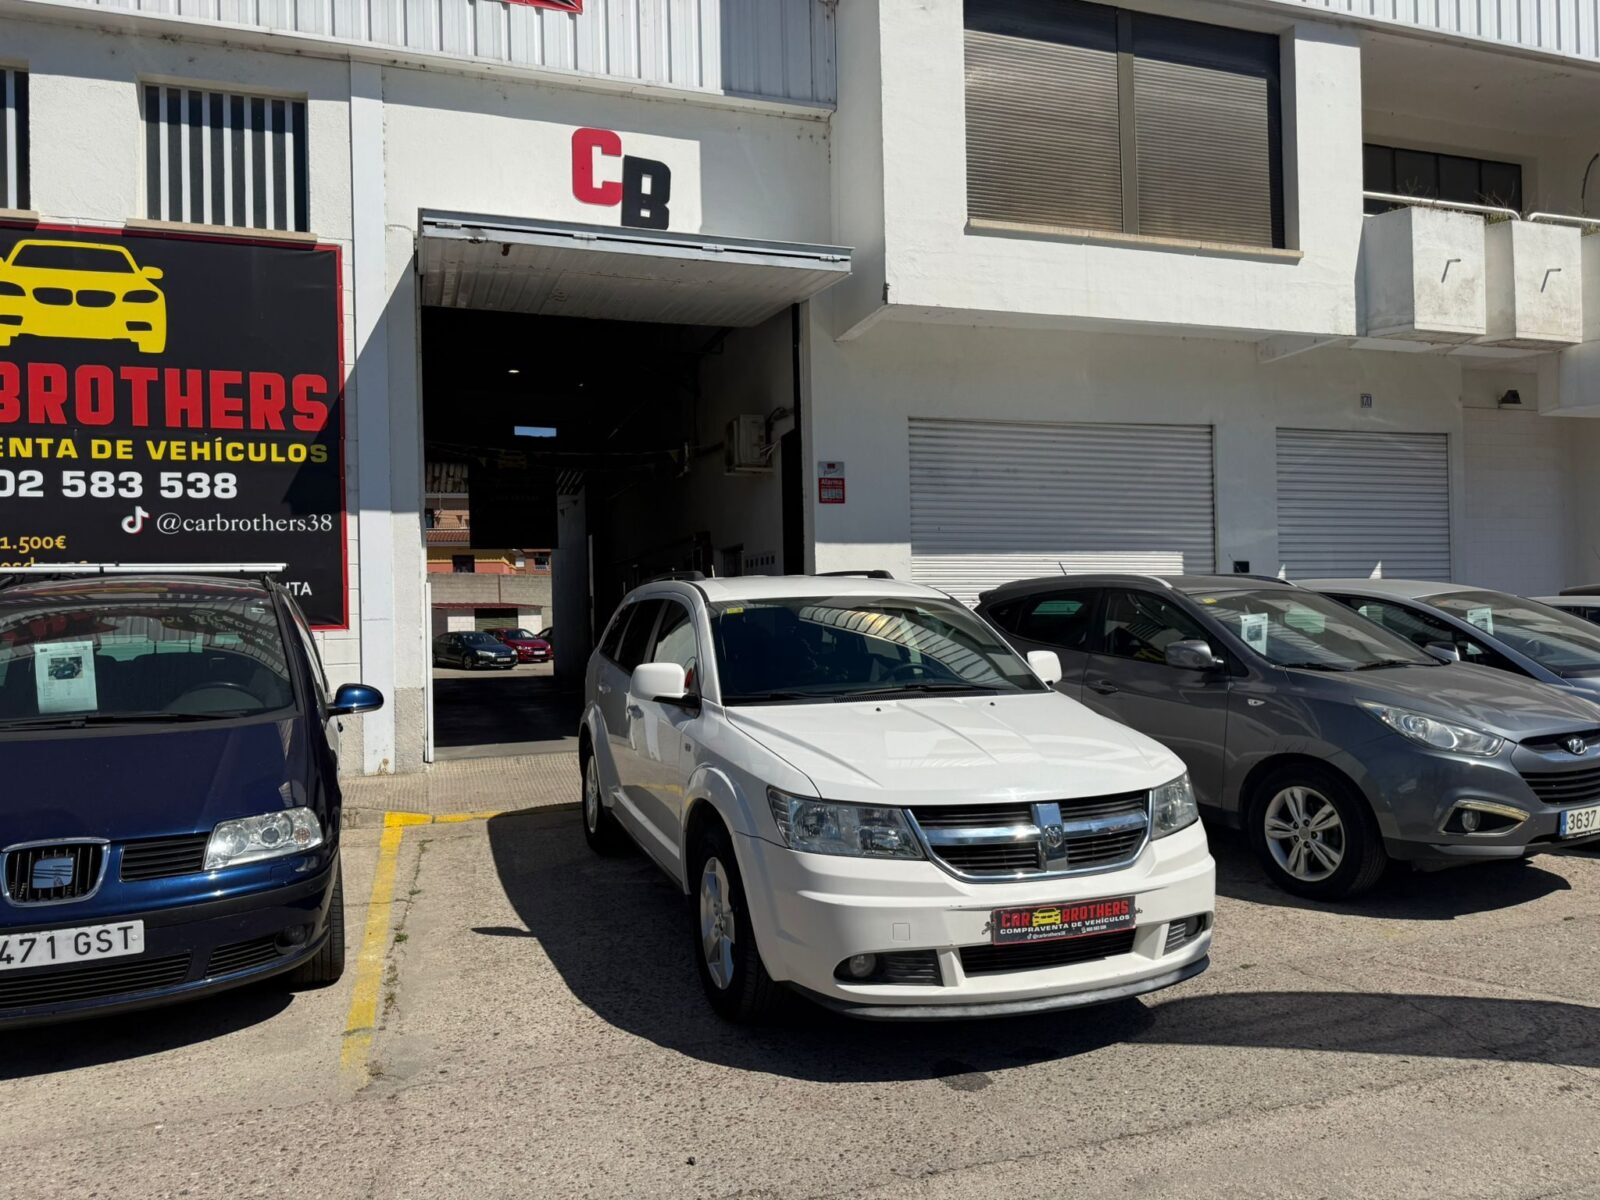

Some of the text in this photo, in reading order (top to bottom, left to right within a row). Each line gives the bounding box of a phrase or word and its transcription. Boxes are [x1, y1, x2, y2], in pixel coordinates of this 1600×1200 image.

[0, 361, 328, 432] BROTHERS
[0, 436, 328, 463] NTA DE VEHÍCULOS
[0, 469, 238, 499] 02 583 538
[156, 512, 333, 535] @carbrothers38
[0, 535, 67, 554] 1.500€
[286, 581, 313, 596] TA
[1569, 810, 1597, 830] 3637
[1000, 922, 1069, 936] COMPRAVENTA
[1071, 920, 1083, 929] DE
[1085, 914, 1130, 926] VEHÍCULOS
[1001, 901, 1129, 928] CAR BROTHERS
[0, 926, 134, 964] 471 GST
